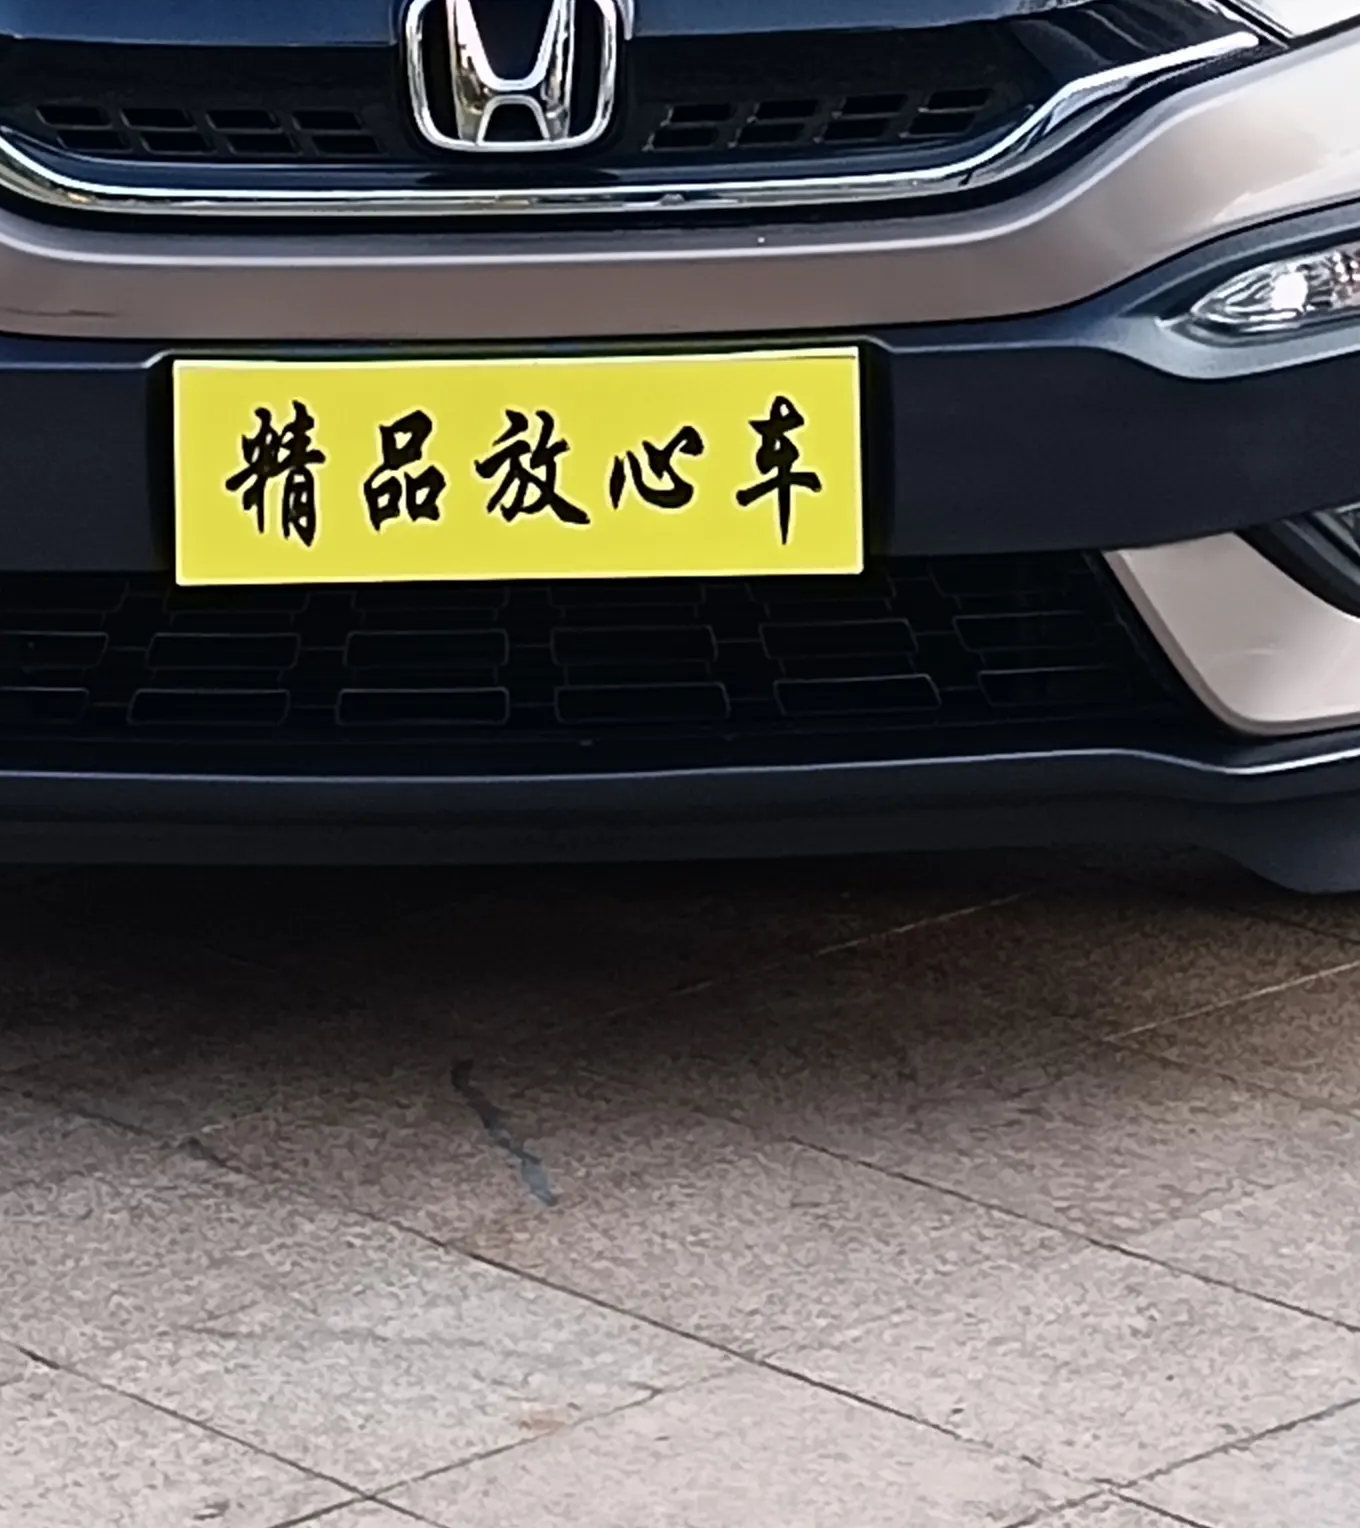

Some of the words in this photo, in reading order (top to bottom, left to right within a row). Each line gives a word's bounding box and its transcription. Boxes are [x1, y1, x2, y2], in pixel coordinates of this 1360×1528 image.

[225, 395, 823, 547] 精品放心车
